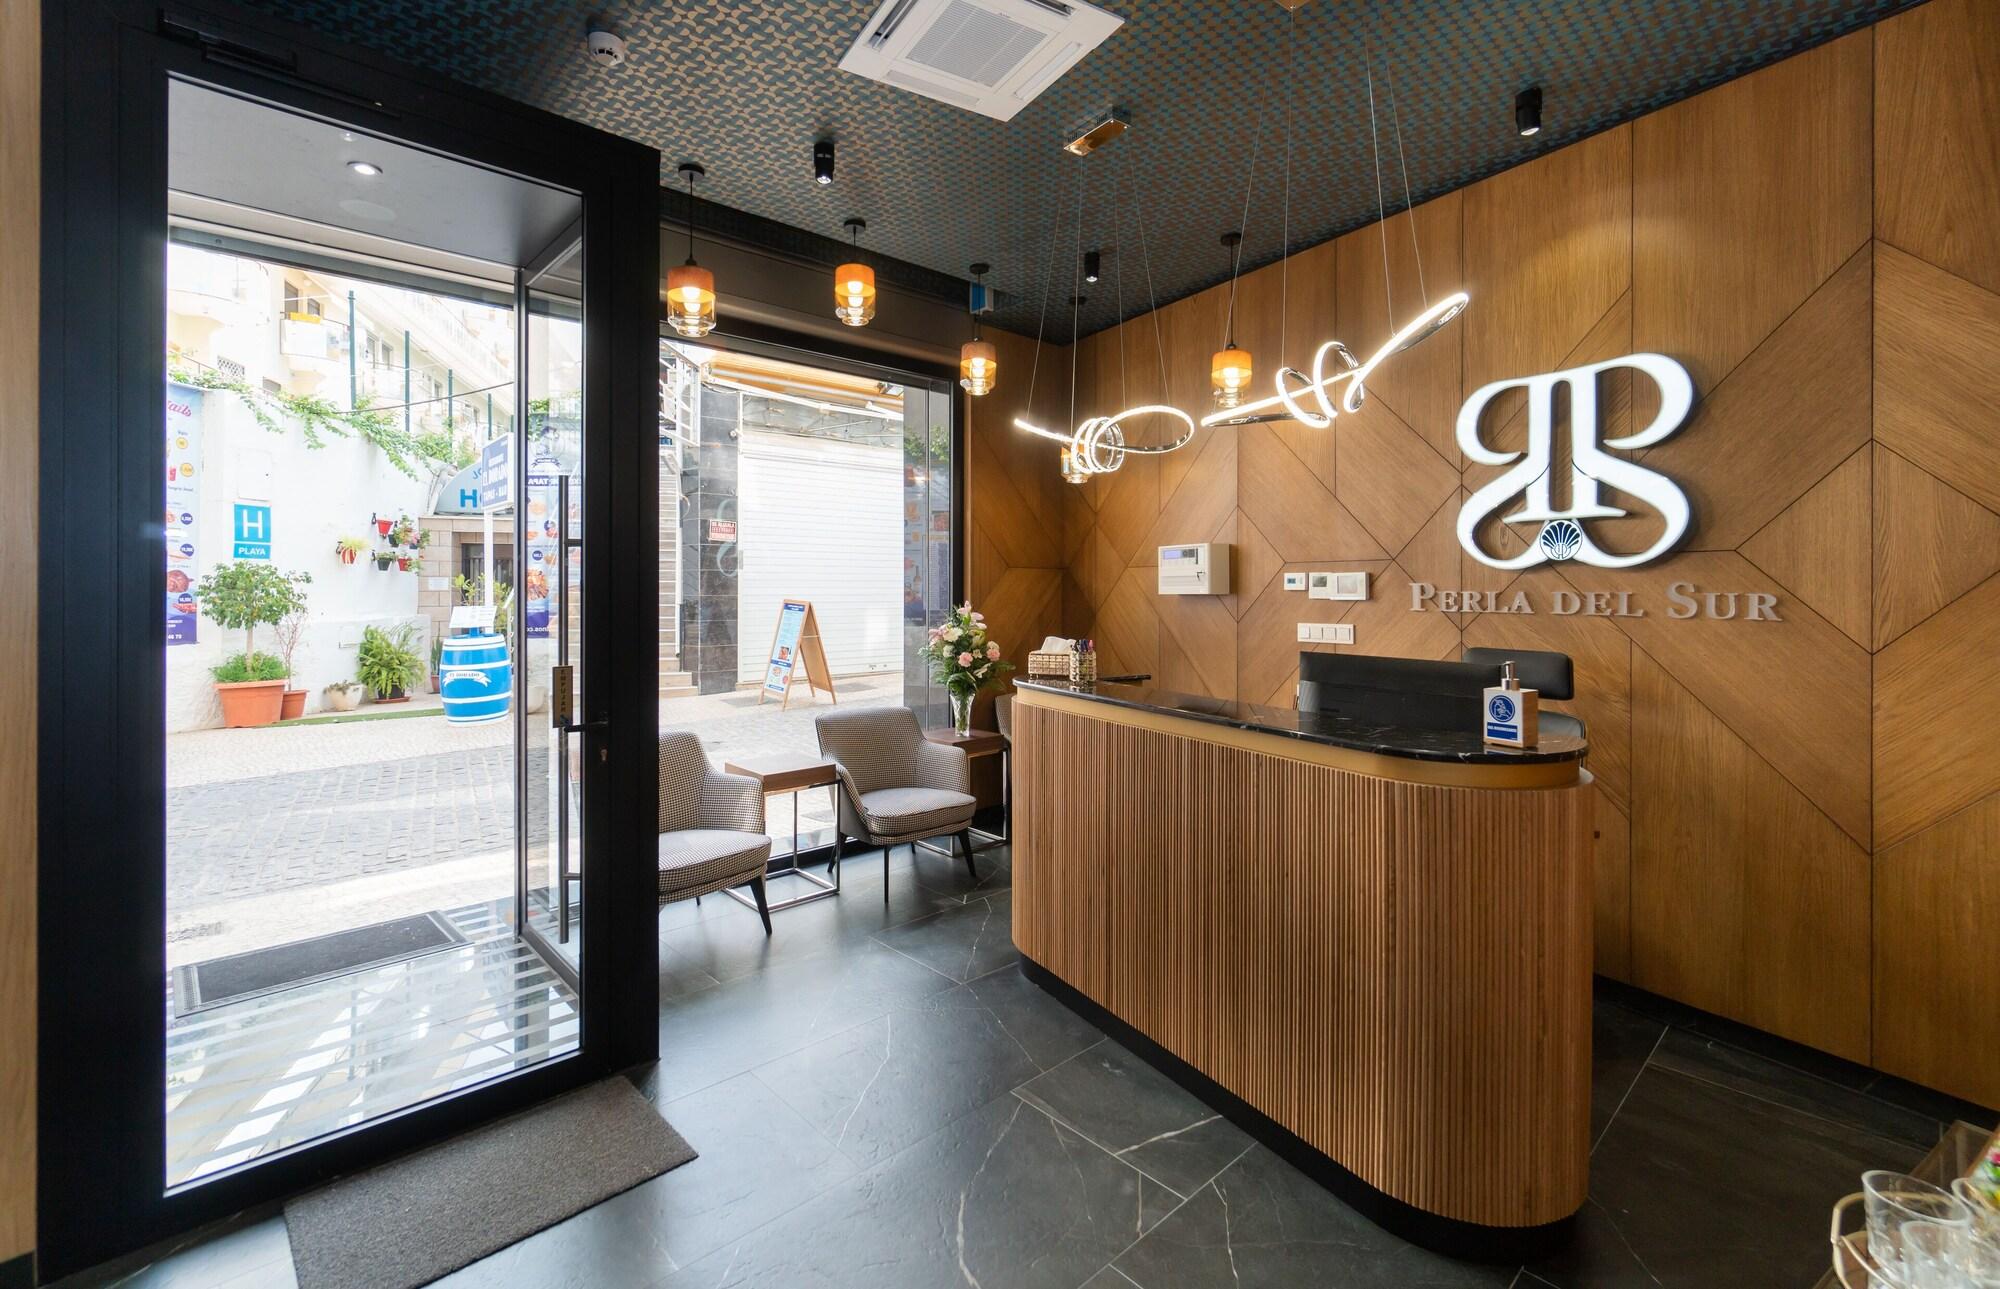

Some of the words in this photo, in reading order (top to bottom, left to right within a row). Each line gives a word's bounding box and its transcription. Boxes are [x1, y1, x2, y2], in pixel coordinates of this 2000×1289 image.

[243, 509, 263, 539] H
[238, 546, 267, 556] PLAYA
[1408, 582, 1535, 614] PERLA
[1551, 590, 1644, 617] DEL
